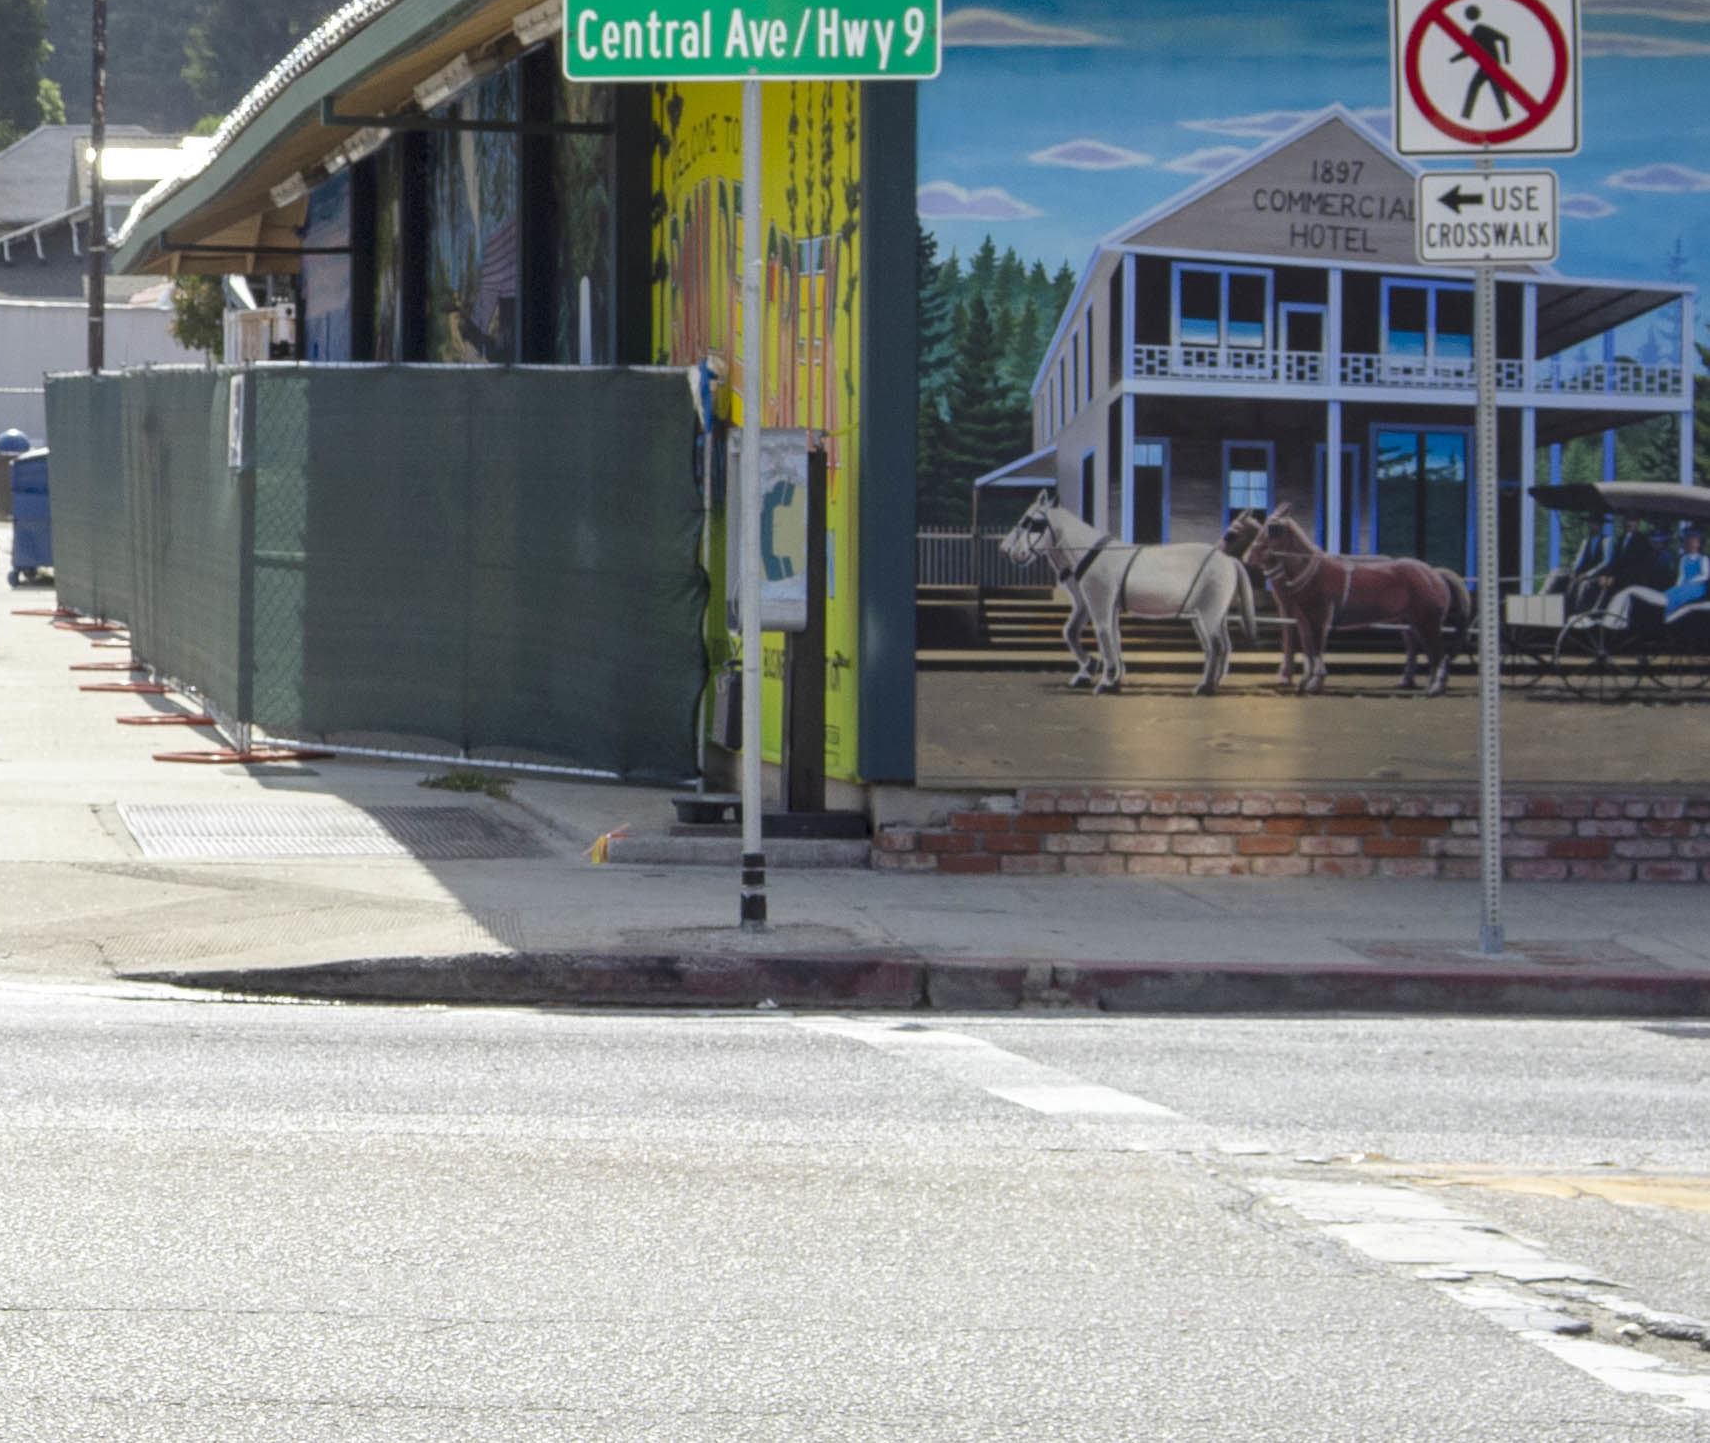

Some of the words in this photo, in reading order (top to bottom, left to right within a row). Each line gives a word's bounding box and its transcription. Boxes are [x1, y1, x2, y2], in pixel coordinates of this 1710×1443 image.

[578, 8, 711, 60] Central
[904, 6, 926, 58] 9
[1311, 160, 1365, 185] 1897
[1253, 188, 1416, 223] COMMERCIAL
[1490, 186, 1540, 212] USE
[1289, 223, 1379, 254] HOTEL
[1426, 221, 1550, 248] CROSSWALK
